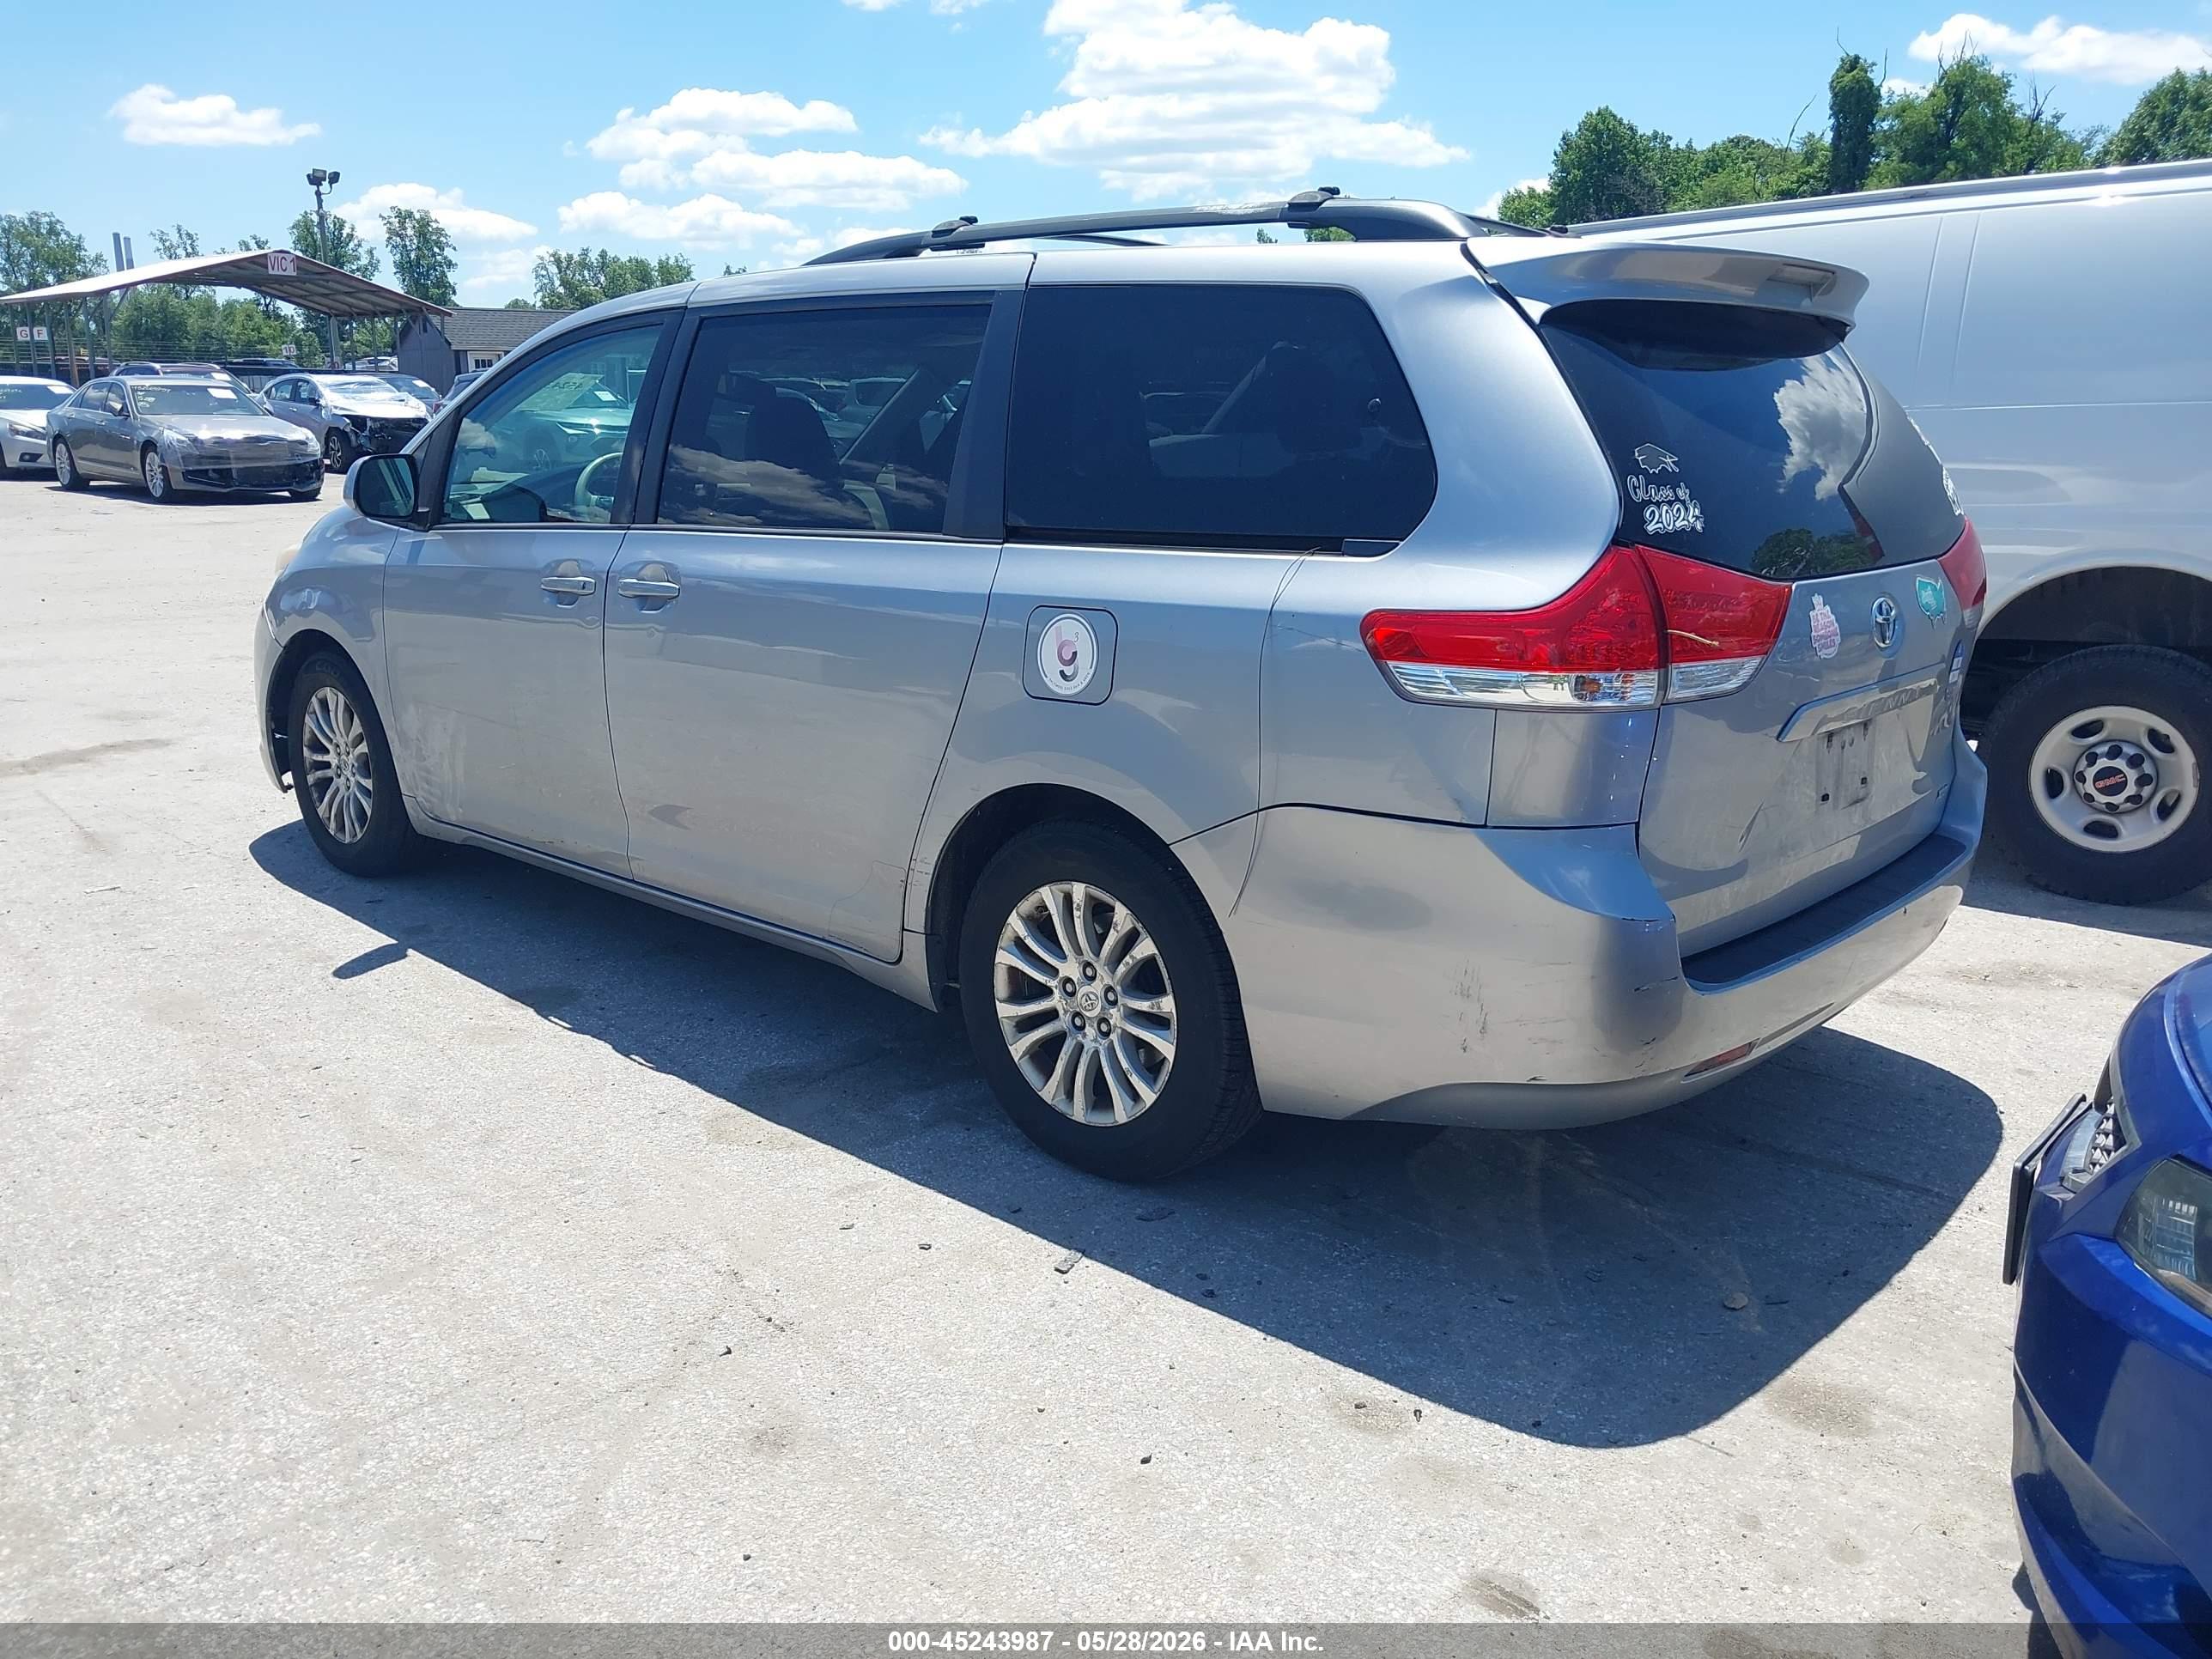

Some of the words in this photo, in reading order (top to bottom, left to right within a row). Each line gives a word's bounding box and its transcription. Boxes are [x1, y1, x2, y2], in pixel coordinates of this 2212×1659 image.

[269, 255, 288, 272] VIC
[290, 257, 296, 272] 1
[20, 329, 28, 338] G
[37, 329, 44, 338] F
[1626, 474, 1675, 502] Class
[1676, 482, 1691, 503] of
[1644, 499, 1705, 535] 2024
[2095, 775, 2126, 788] GMC
